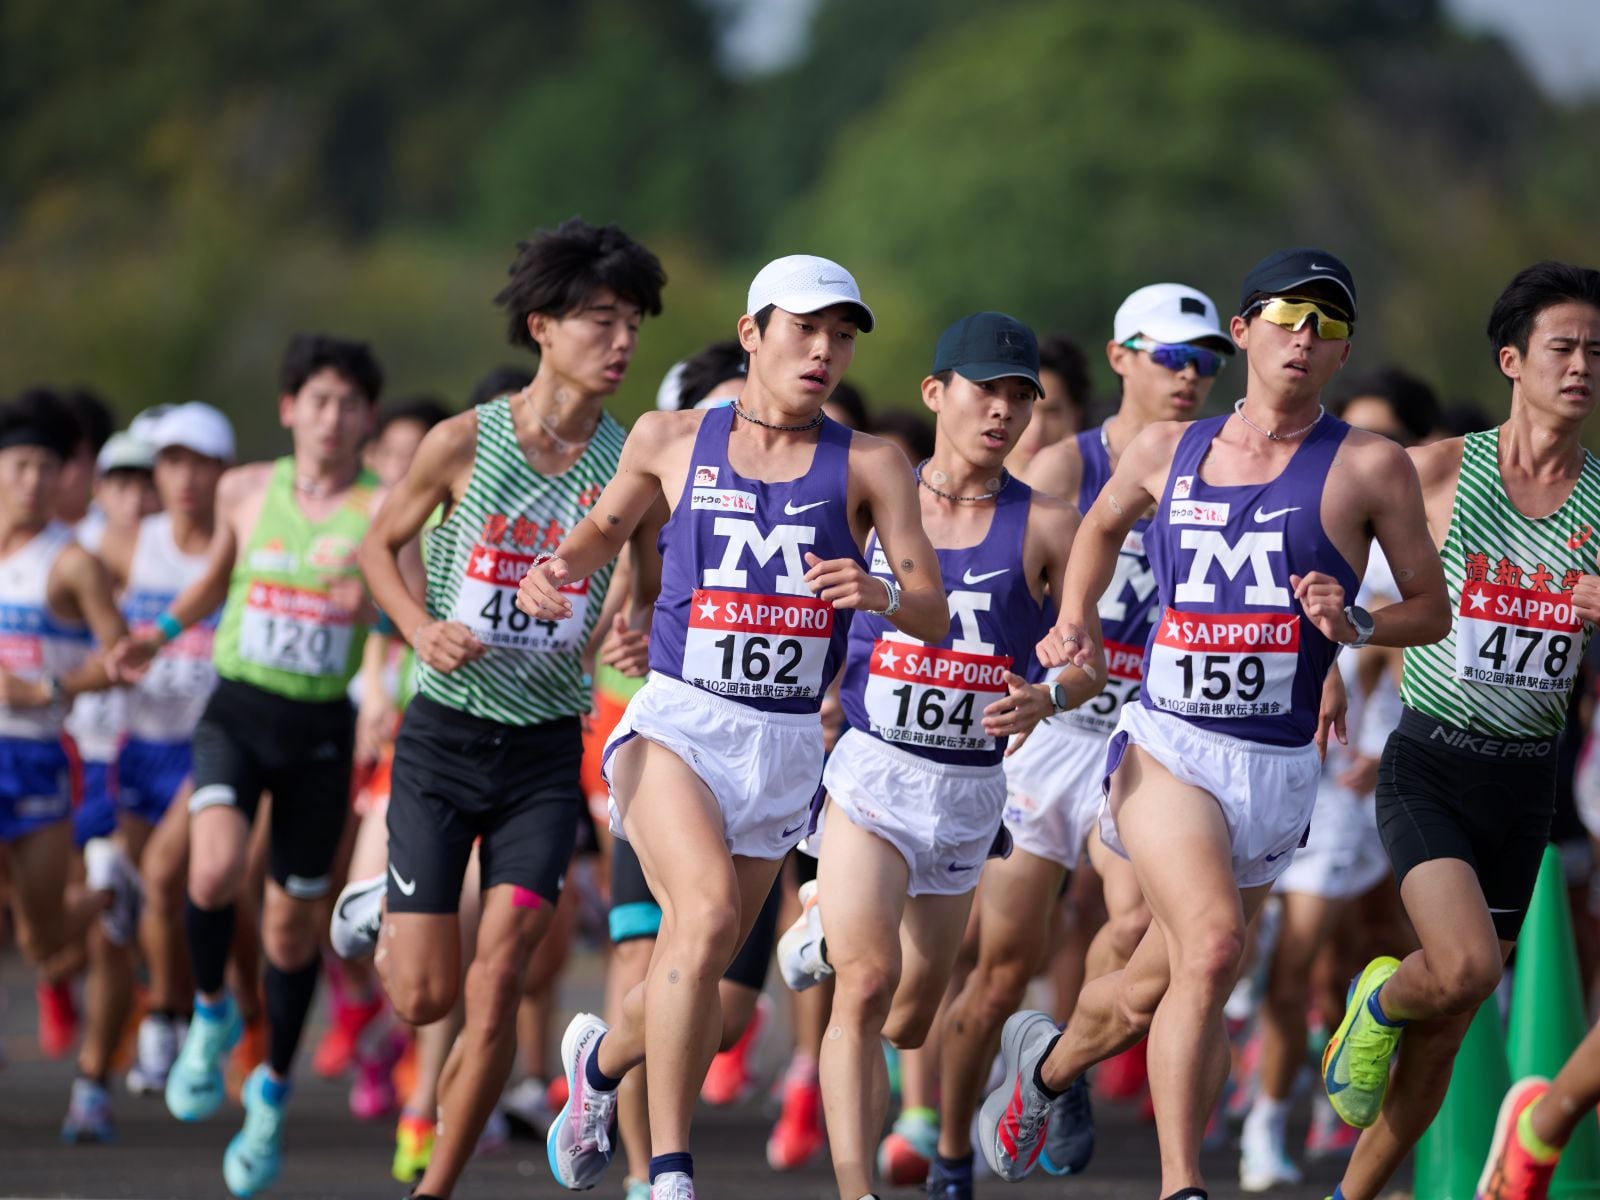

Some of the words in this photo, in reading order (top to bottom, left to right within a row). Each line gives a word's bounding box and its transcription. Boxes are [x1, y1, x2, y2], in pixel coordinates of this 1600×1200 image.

[482, 514, 564, 548] 清和大
[703, 517, 816, 598] M
[1175, 529, 1291, 607] M
[724, 601, 828, 630] SAPPORO
[1495, 594, 1583, 627] SAPPOR
[264, 619, 332, 661] 120
[1183, 622, 1292, 646] SAPPORO
[714, 634, 804, 685] 162
[903, 653, 1006, 686] SAPPORO
[1478, 626, 1572, 679] 478
[1175, 654, 1266, 702] 159
[892, 684, 977, 736] 164
[1157, 696, 1281, 716] 第102回箱根駅伝予選会
[876, 723, 987, 750] 102回箱根駅伝予選会
[1430, 725, 1503, 757] NIKE
[1502, 741, 1551, 758] PRO
